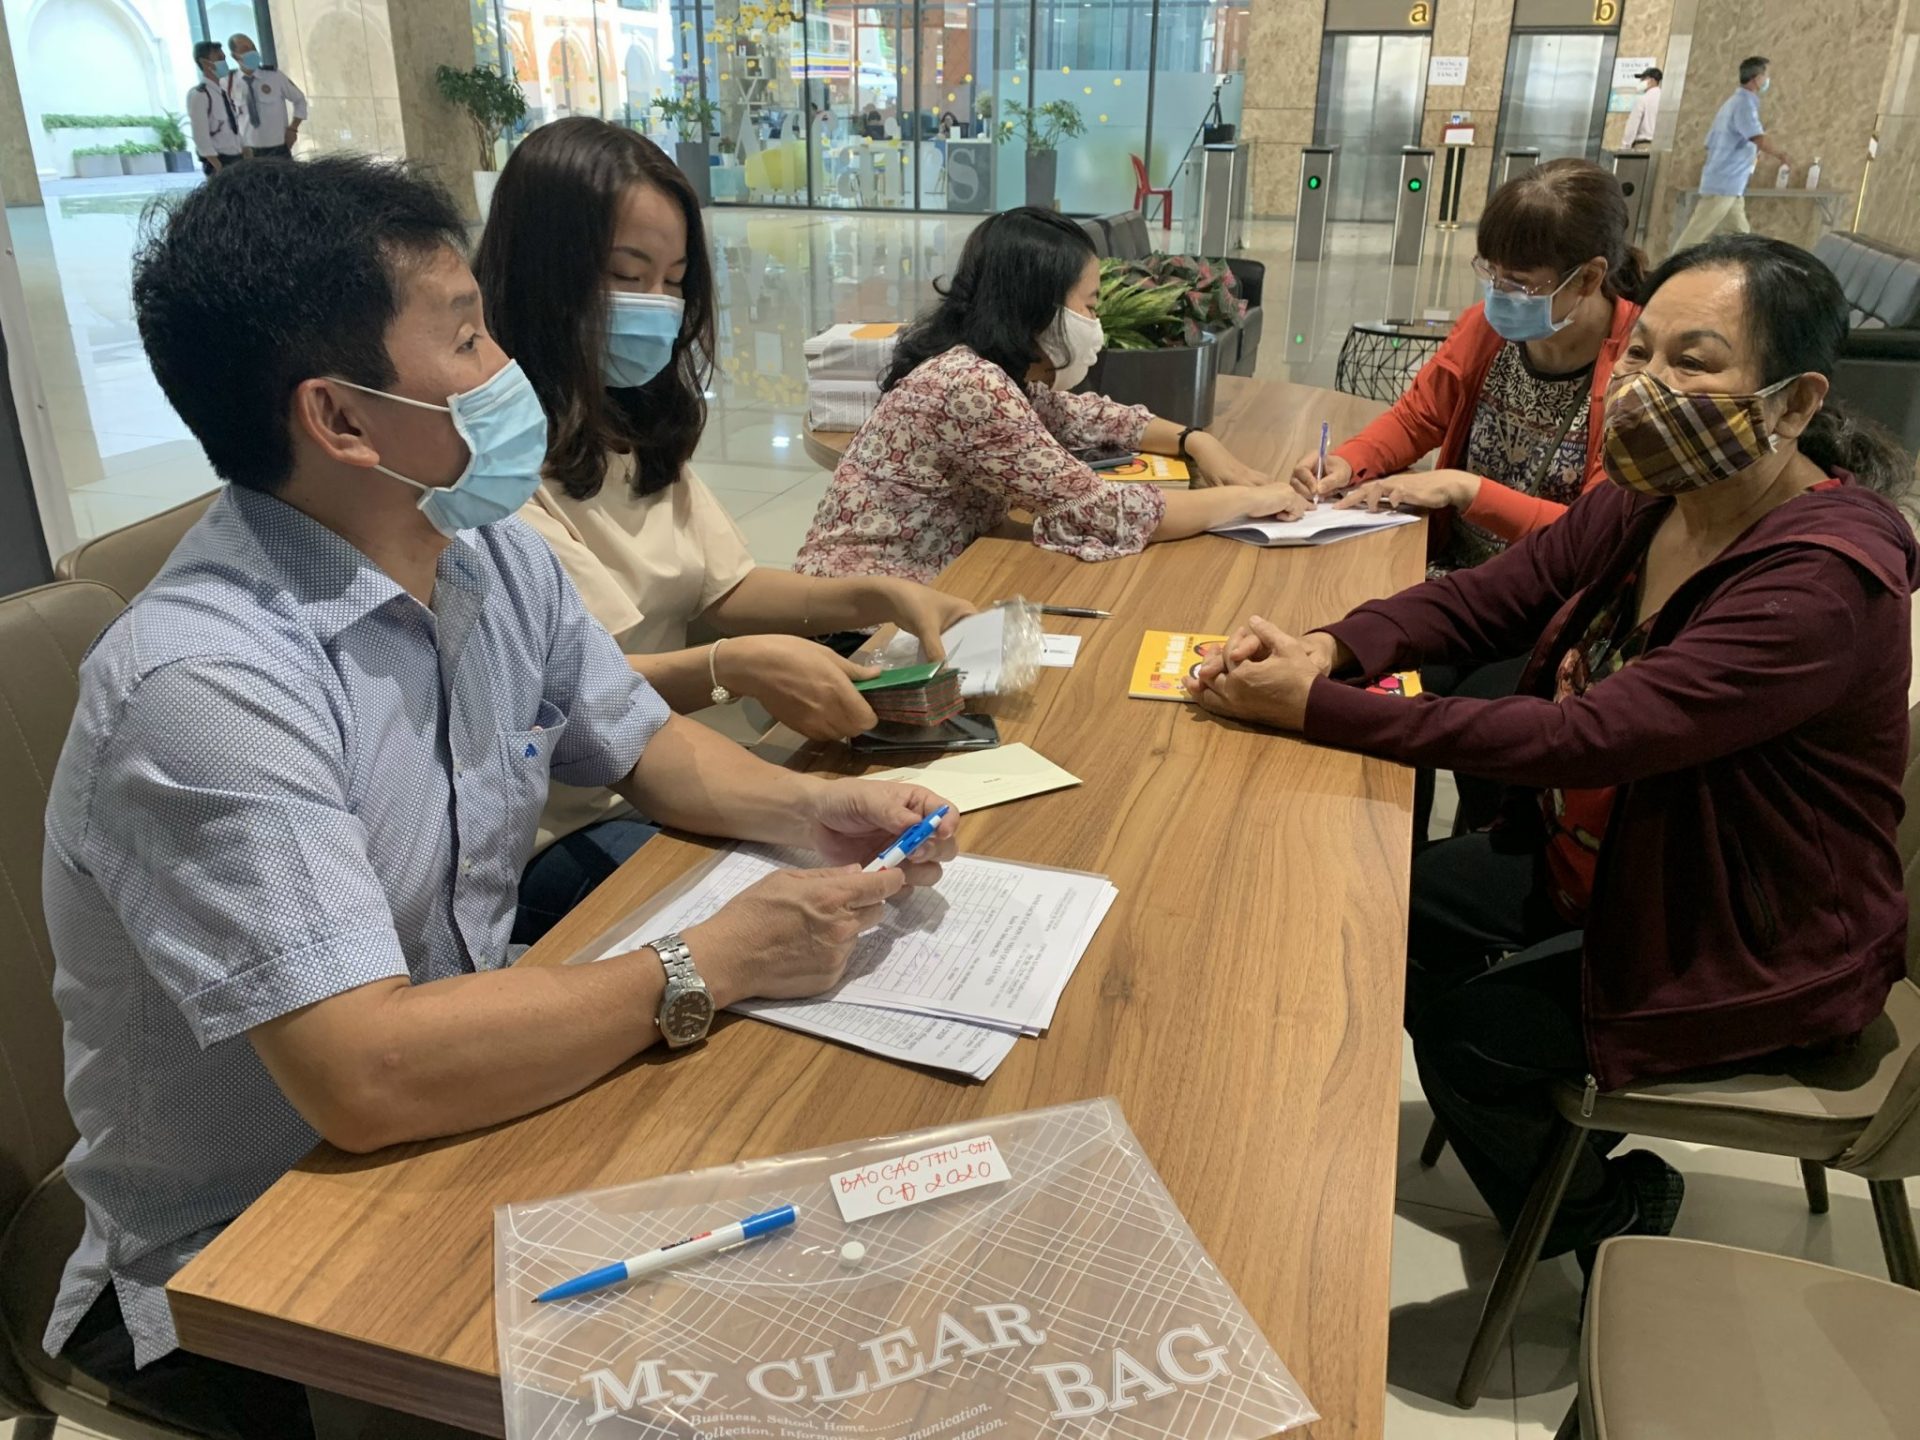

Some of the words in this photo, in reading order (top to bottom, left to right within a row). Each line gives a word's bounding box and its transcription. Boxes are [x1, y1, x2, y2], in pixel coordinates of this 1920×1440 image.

[1411, 2, 1428, 23] a
[1594, 0, 1616, 22] b
[925, 1161, 991, 1194] 2020
[580, 1358, 718, 1426] My
[746, 1302, 1048, 1404] CLEAR
[1029, 1323, 1232, 1421] BAG
[691, 1411, 761, 1426] Business,
[766, 1415, 819, 1430] School,
